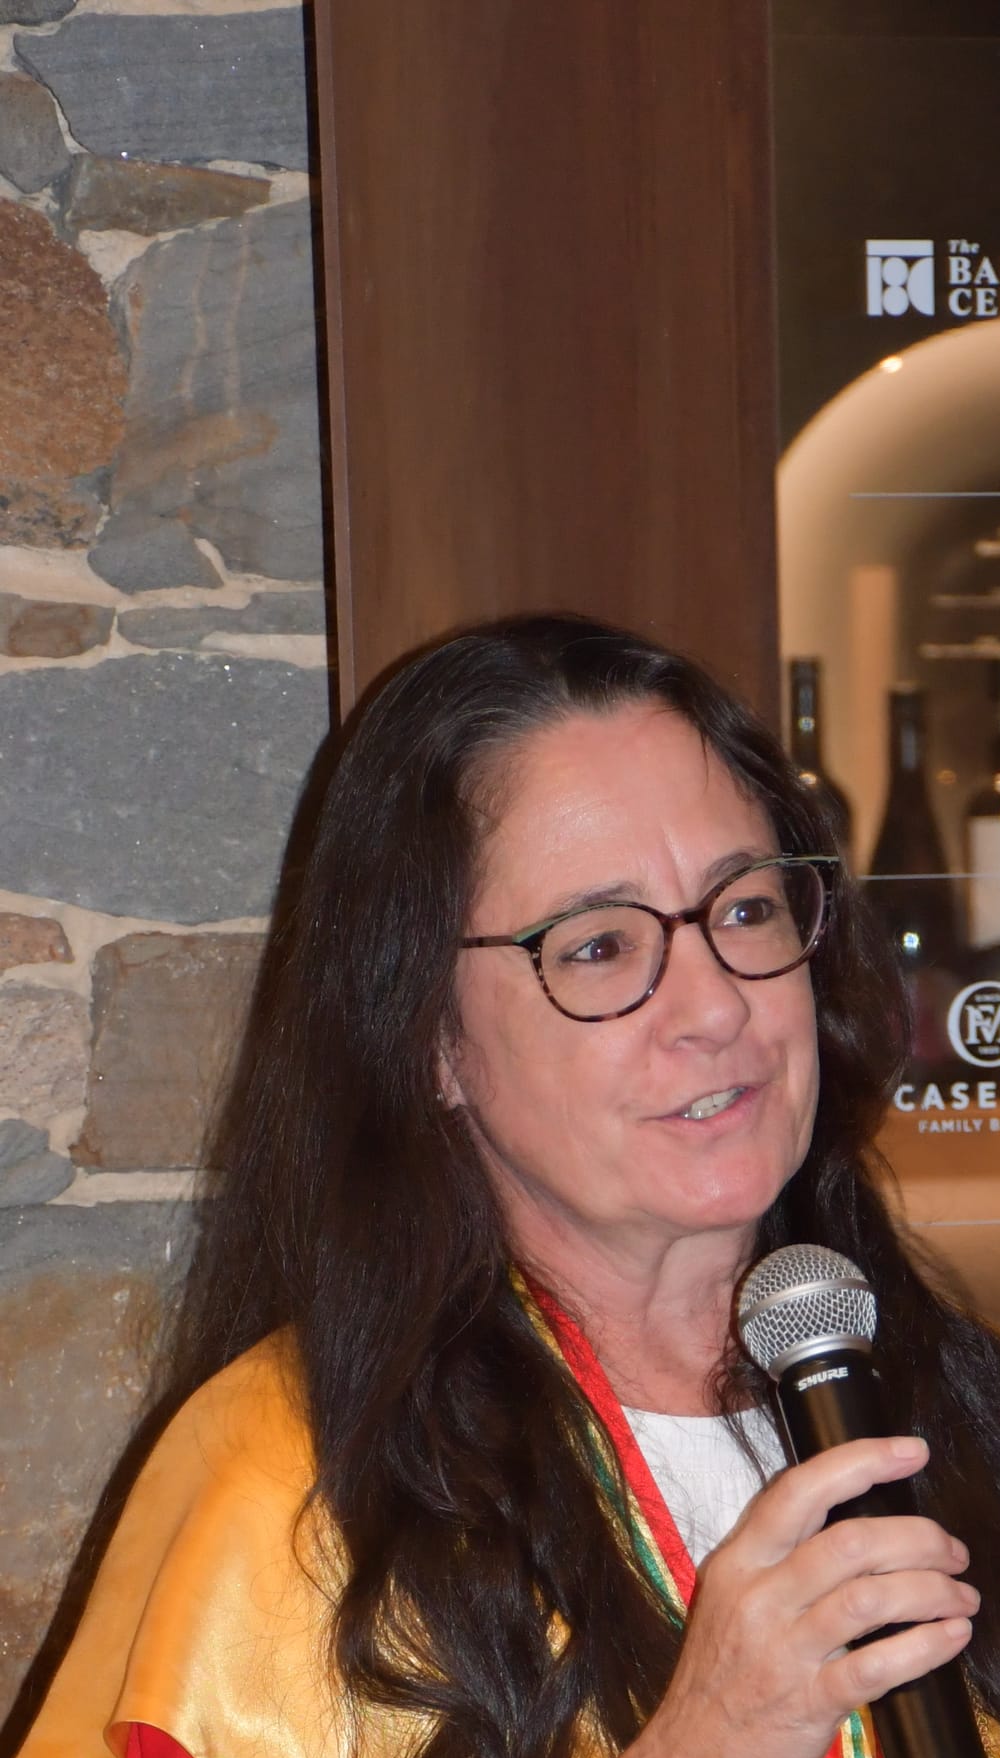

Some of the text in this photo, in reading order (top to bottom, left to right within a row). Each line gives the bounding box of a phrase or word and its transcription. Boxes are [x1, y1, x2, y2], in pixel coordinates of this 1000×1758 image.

[948, 239, 980, 254] The
[918, 1118, 983, 1133] FAMILY
[798, 1367, 848, 1392] SHURE
